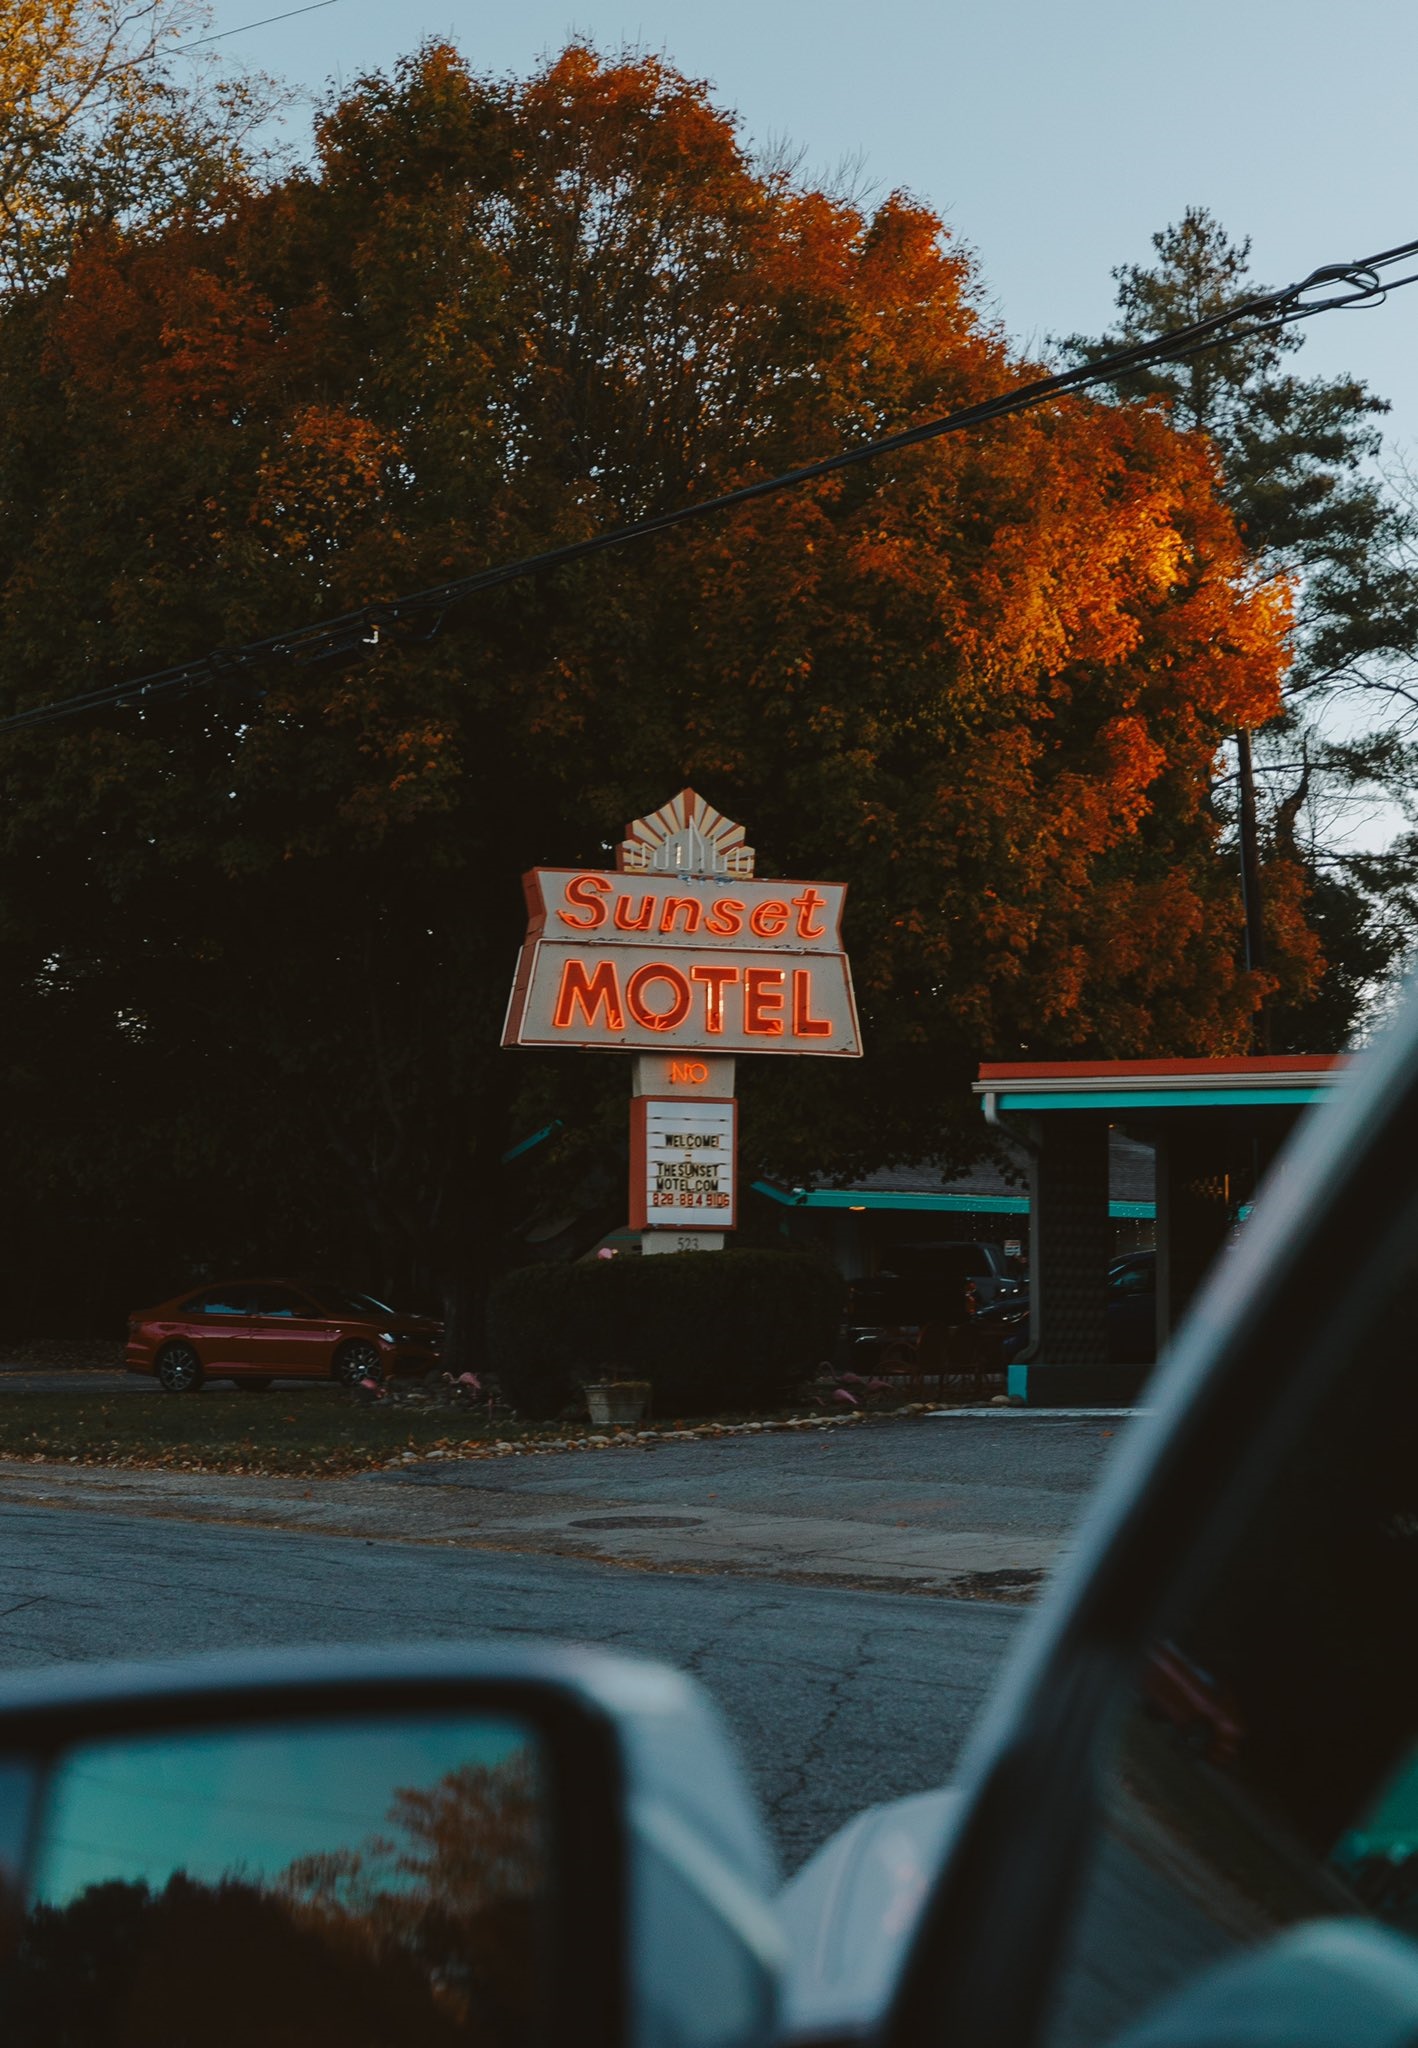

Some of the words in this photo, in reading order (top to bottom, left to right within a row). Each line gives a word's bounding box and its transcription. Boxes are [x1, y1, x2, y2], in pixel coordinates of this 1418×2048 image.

[557, 875, 826, 938] Sunset
[553, 959, 832, 1036] MOTEL
[671, 1062, 708, 1083] NO
[677, 1237, 699, 1251] 523
